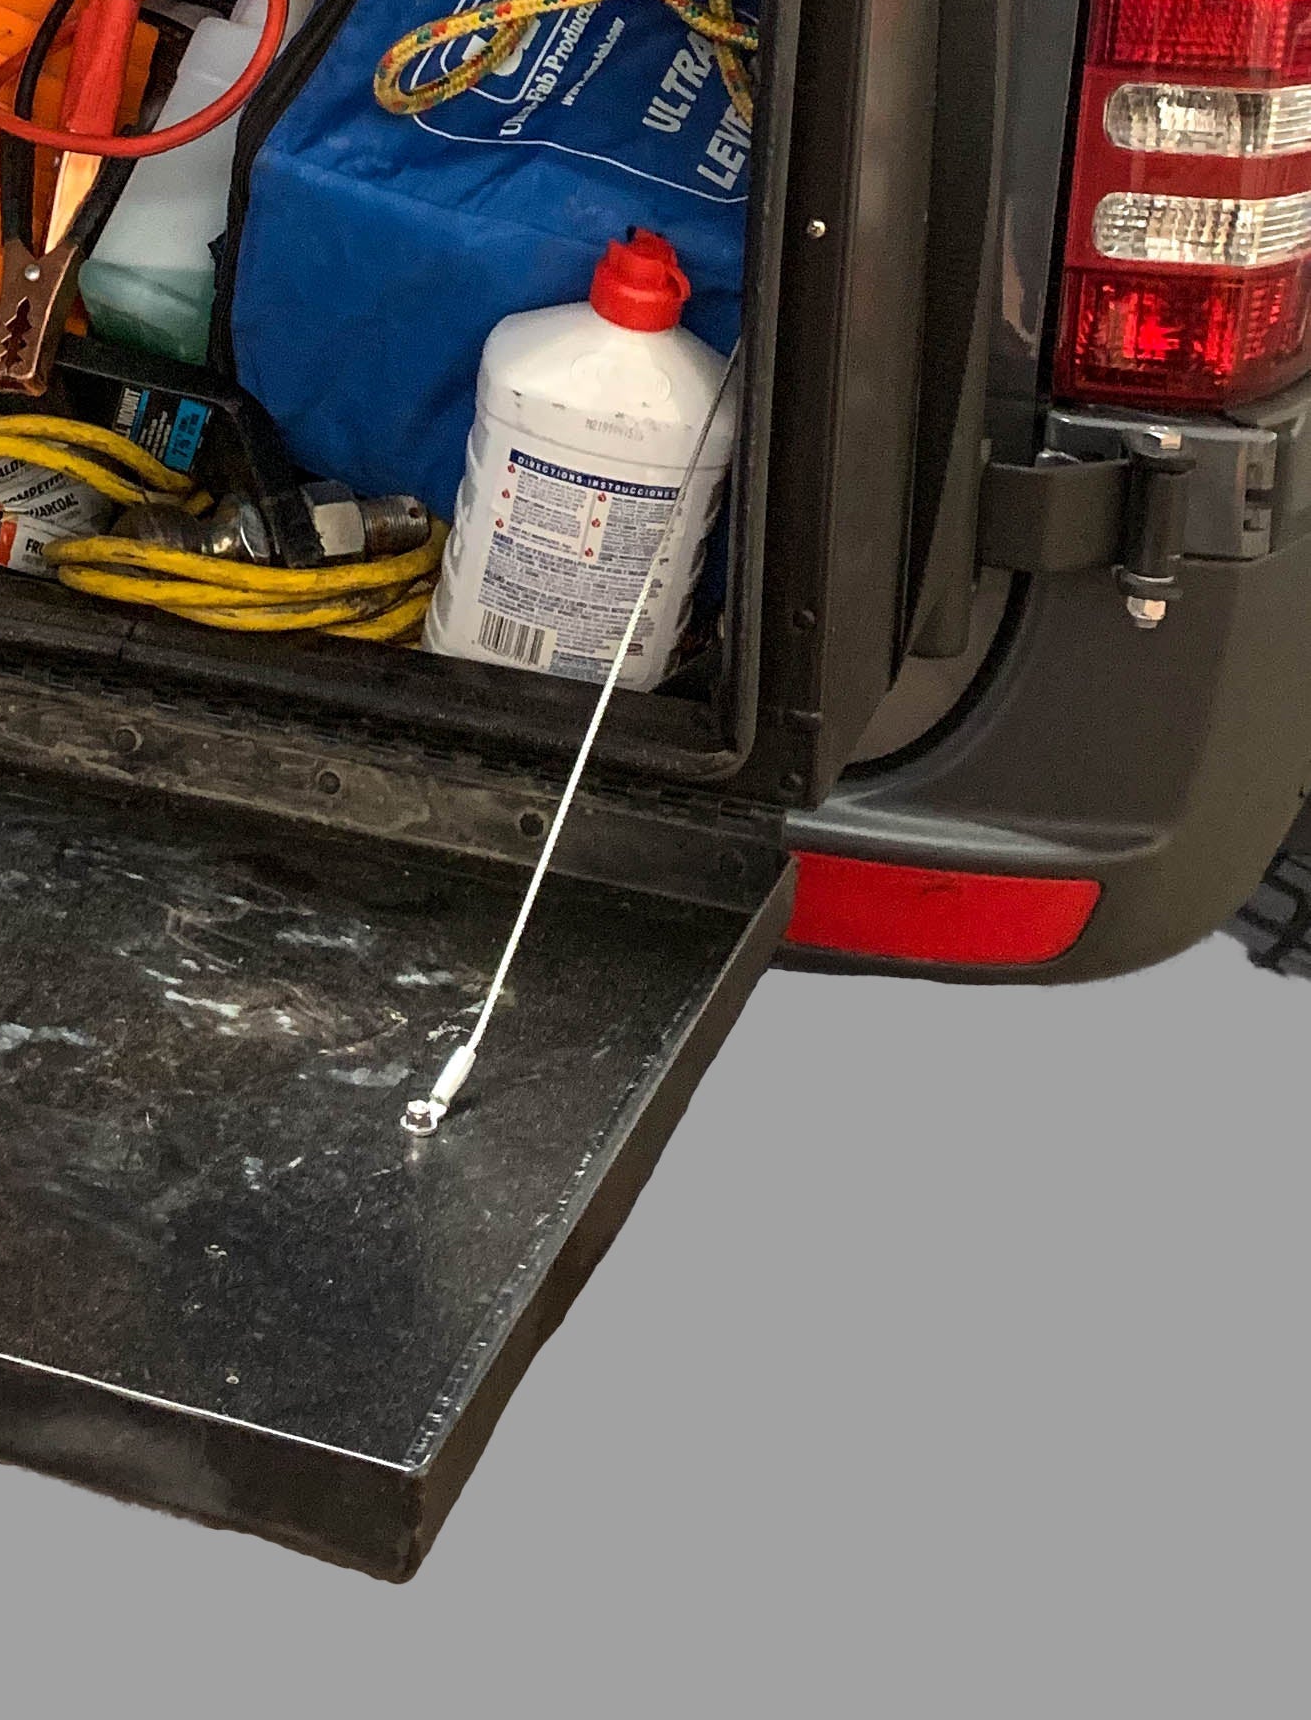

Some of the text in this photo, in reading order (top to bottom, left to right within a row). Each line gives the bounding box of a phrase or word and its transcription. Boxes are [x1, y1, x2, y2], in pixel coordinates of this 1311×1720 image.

[642, 30, 717, 132] ULTRA
[517, 455, 677, 499] DIRECTIONS INSTRUCCIONES
